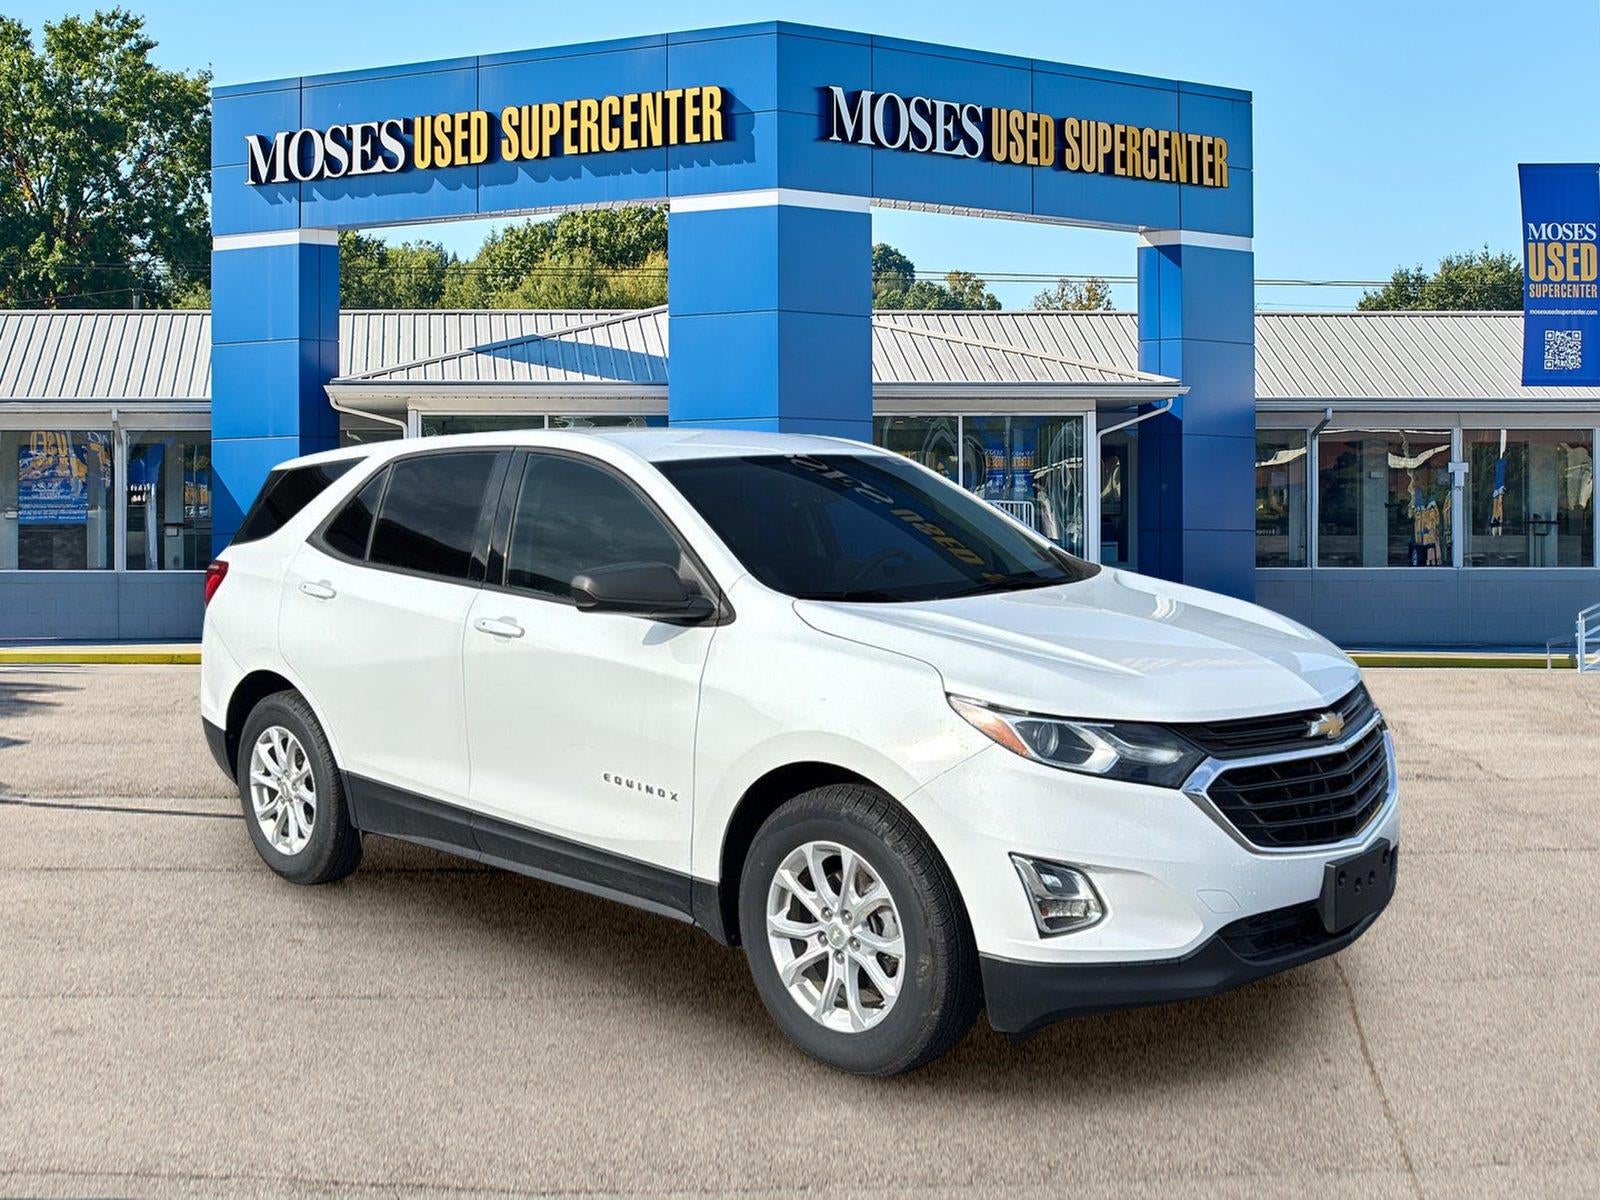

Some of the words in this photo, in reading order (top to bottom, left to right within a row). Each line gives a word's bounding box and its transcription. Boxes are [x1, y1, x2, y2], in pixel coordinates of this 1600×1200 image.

[244, 118, 406, 185] MOSES
[413, 110, 488, 170] USED
[500, 85, 724, 162] SUPERCENTER
[828, 85, 984, 159] MOSES
[991, 107, 1055, 167] USED
[1064, 117, 1229, 188] SUPERCENTER
[1527, 222, 1597, 241] MOSES
[1528, 242, 1598, 282] USED
[1529, 283, 1598, 298] SUPERCENTER
[1529, 308, 1598, 316] mosesusedsupercenter.com
[603, 773, 678, 801] EQUINOX
